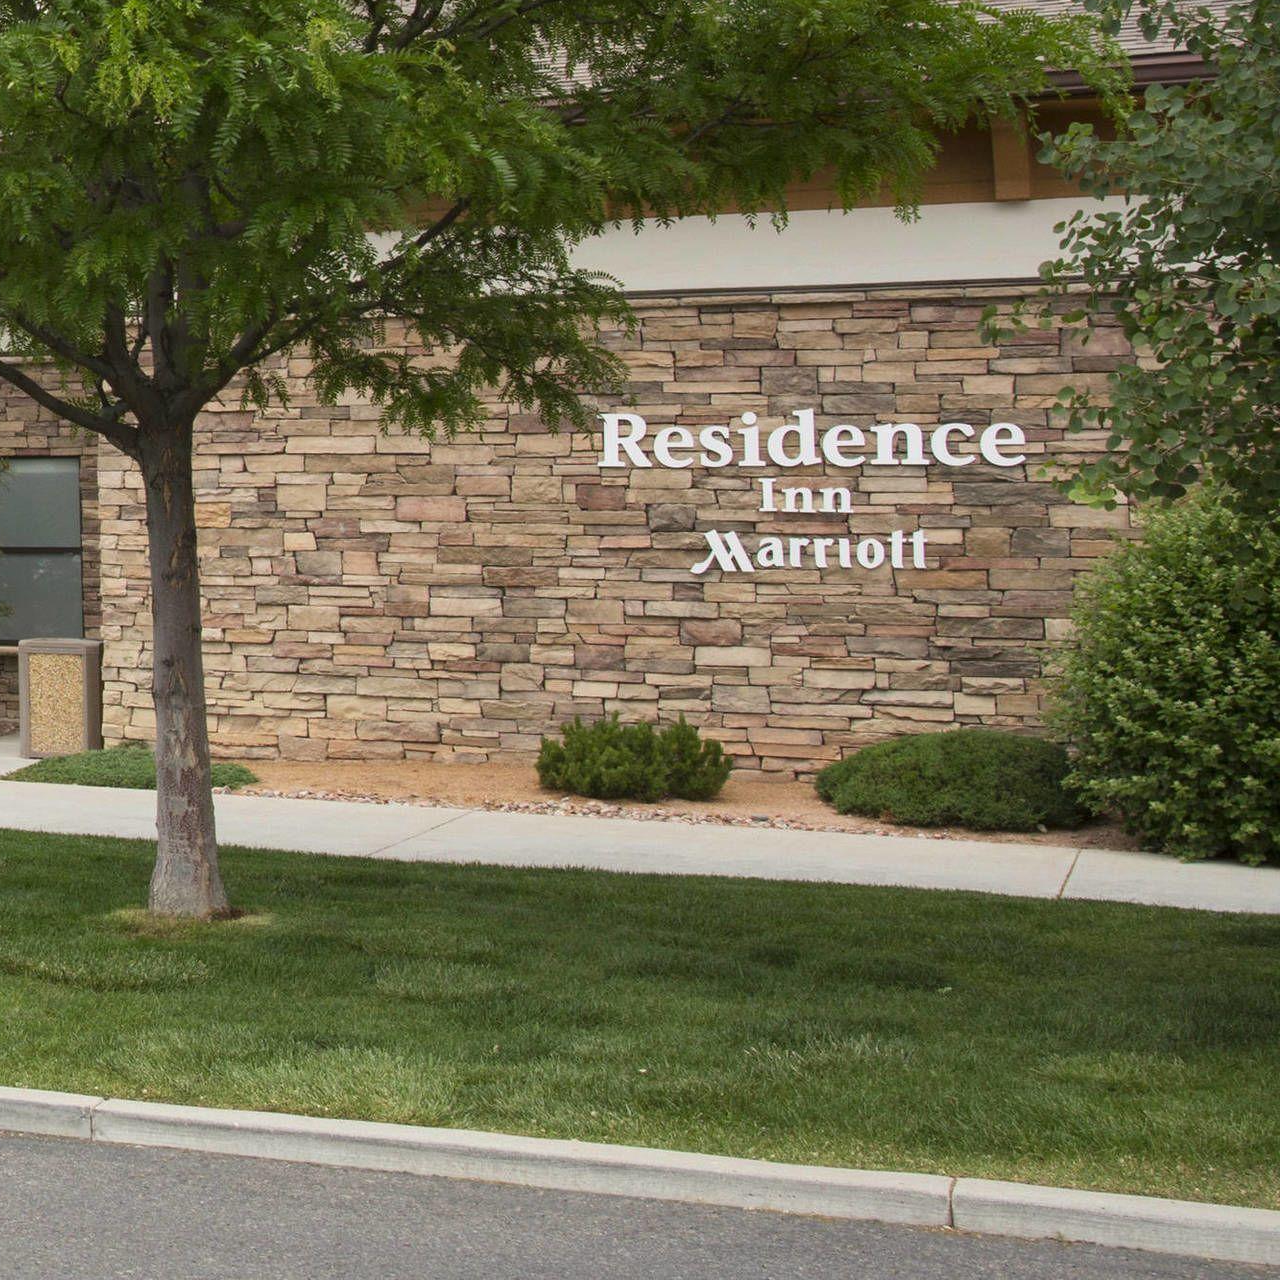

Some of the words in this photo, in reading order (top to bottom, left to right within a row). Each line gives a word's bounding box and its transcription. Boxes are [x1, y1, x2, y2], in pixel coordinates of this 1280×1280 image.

[597, 408, 1027, 468] Residence
[758, 478, 854, 513] Inn
[690, 529, 928, 574] Marriott
